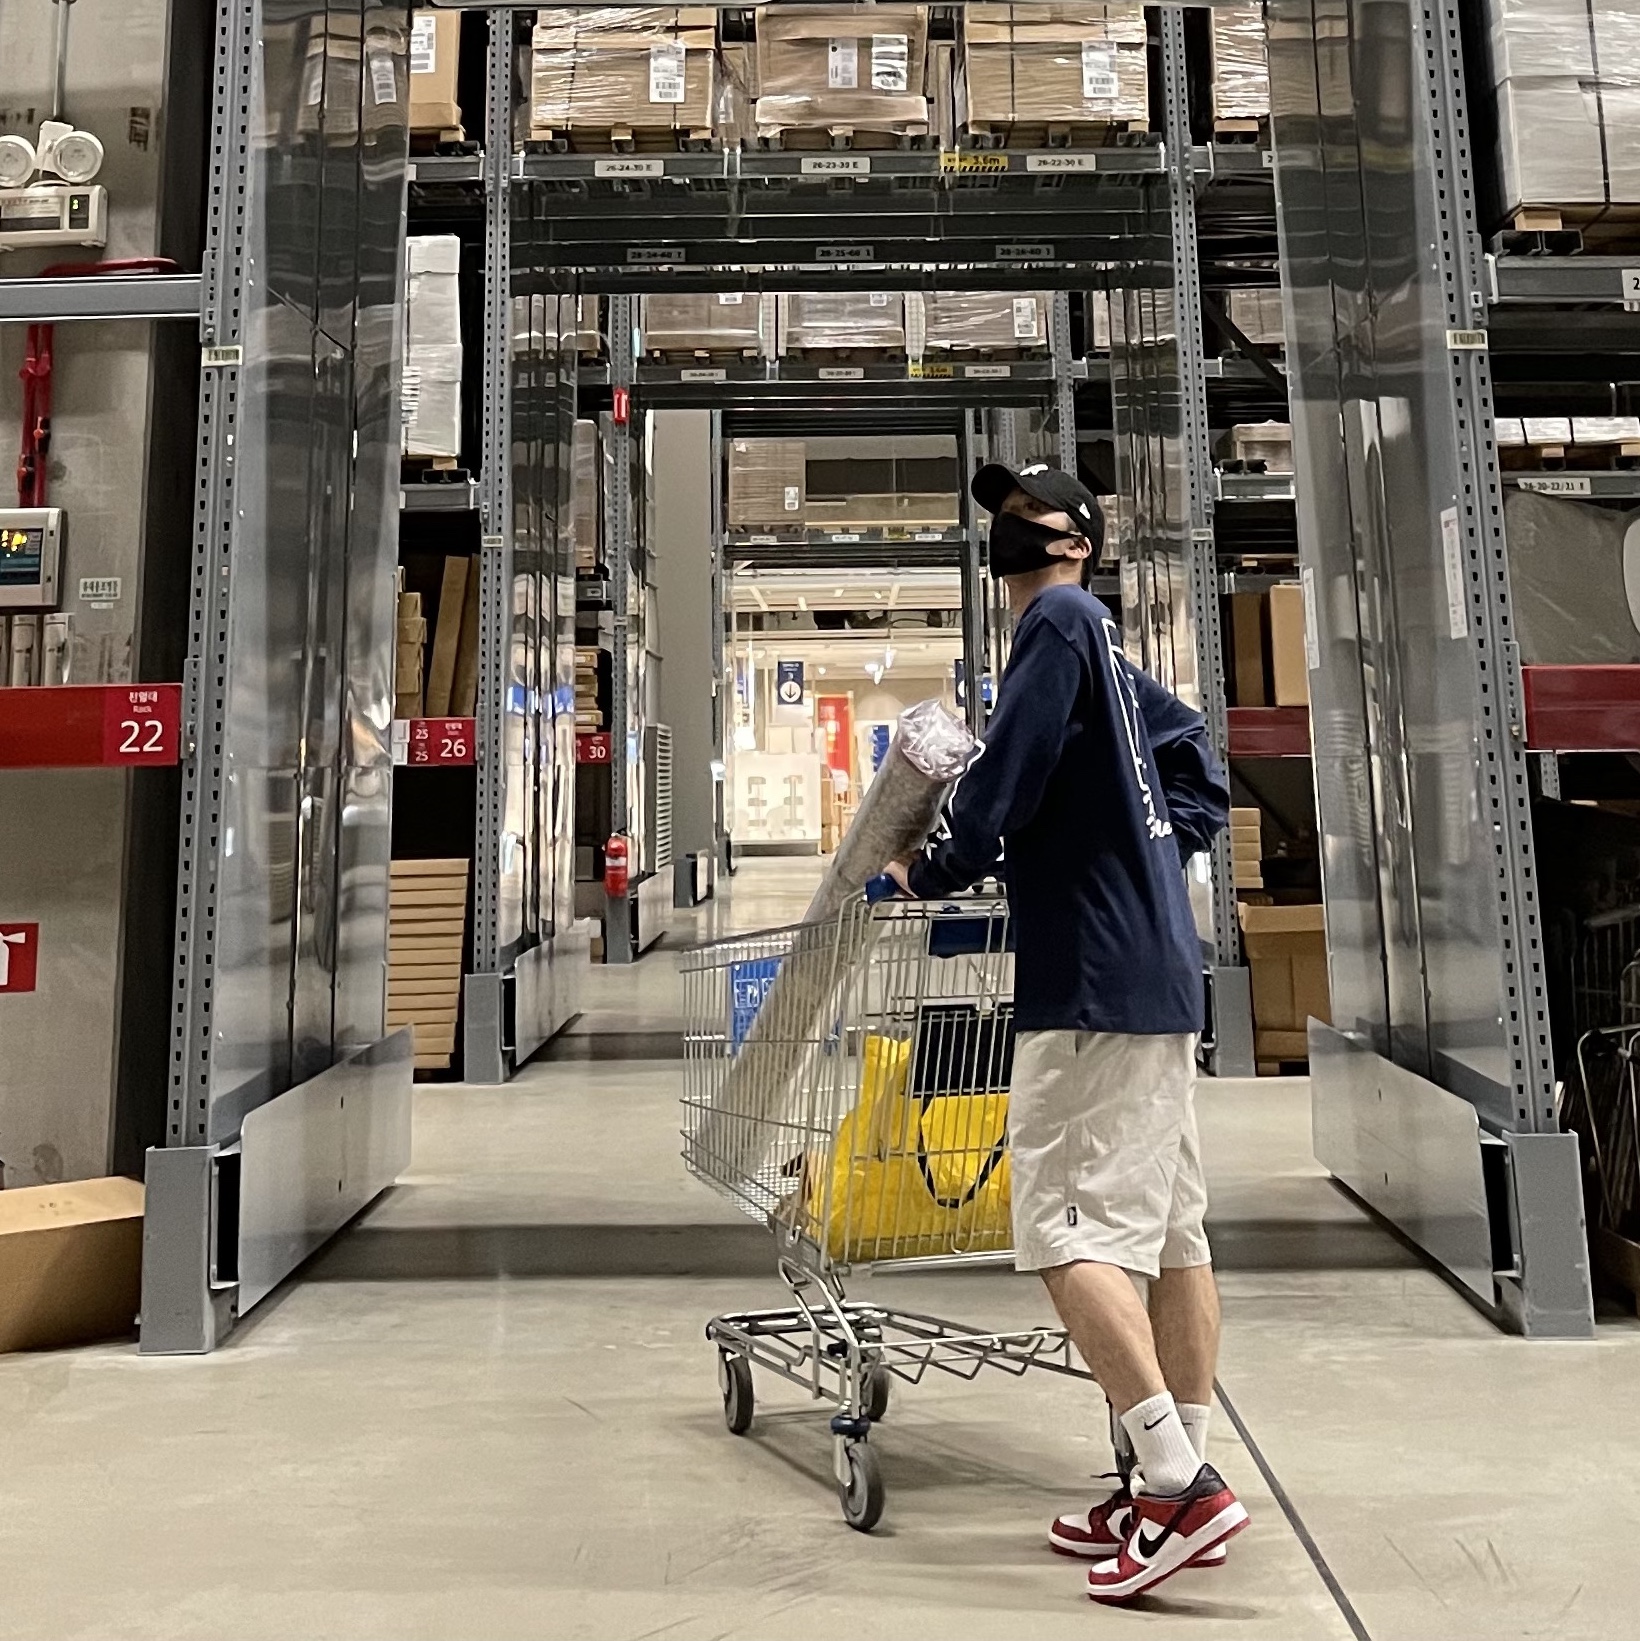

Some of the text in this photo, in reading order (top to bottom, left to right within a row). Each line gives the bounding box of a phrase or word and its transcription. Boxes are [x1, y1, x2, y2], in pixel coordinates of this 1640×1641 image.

[119, 720, 164, 752] 22
[415, 728, 429, 740] 25
[440, 738, 467, 758] 26
[588, 744, 606, 759] 30
[415, 750, 429, 762] 25
